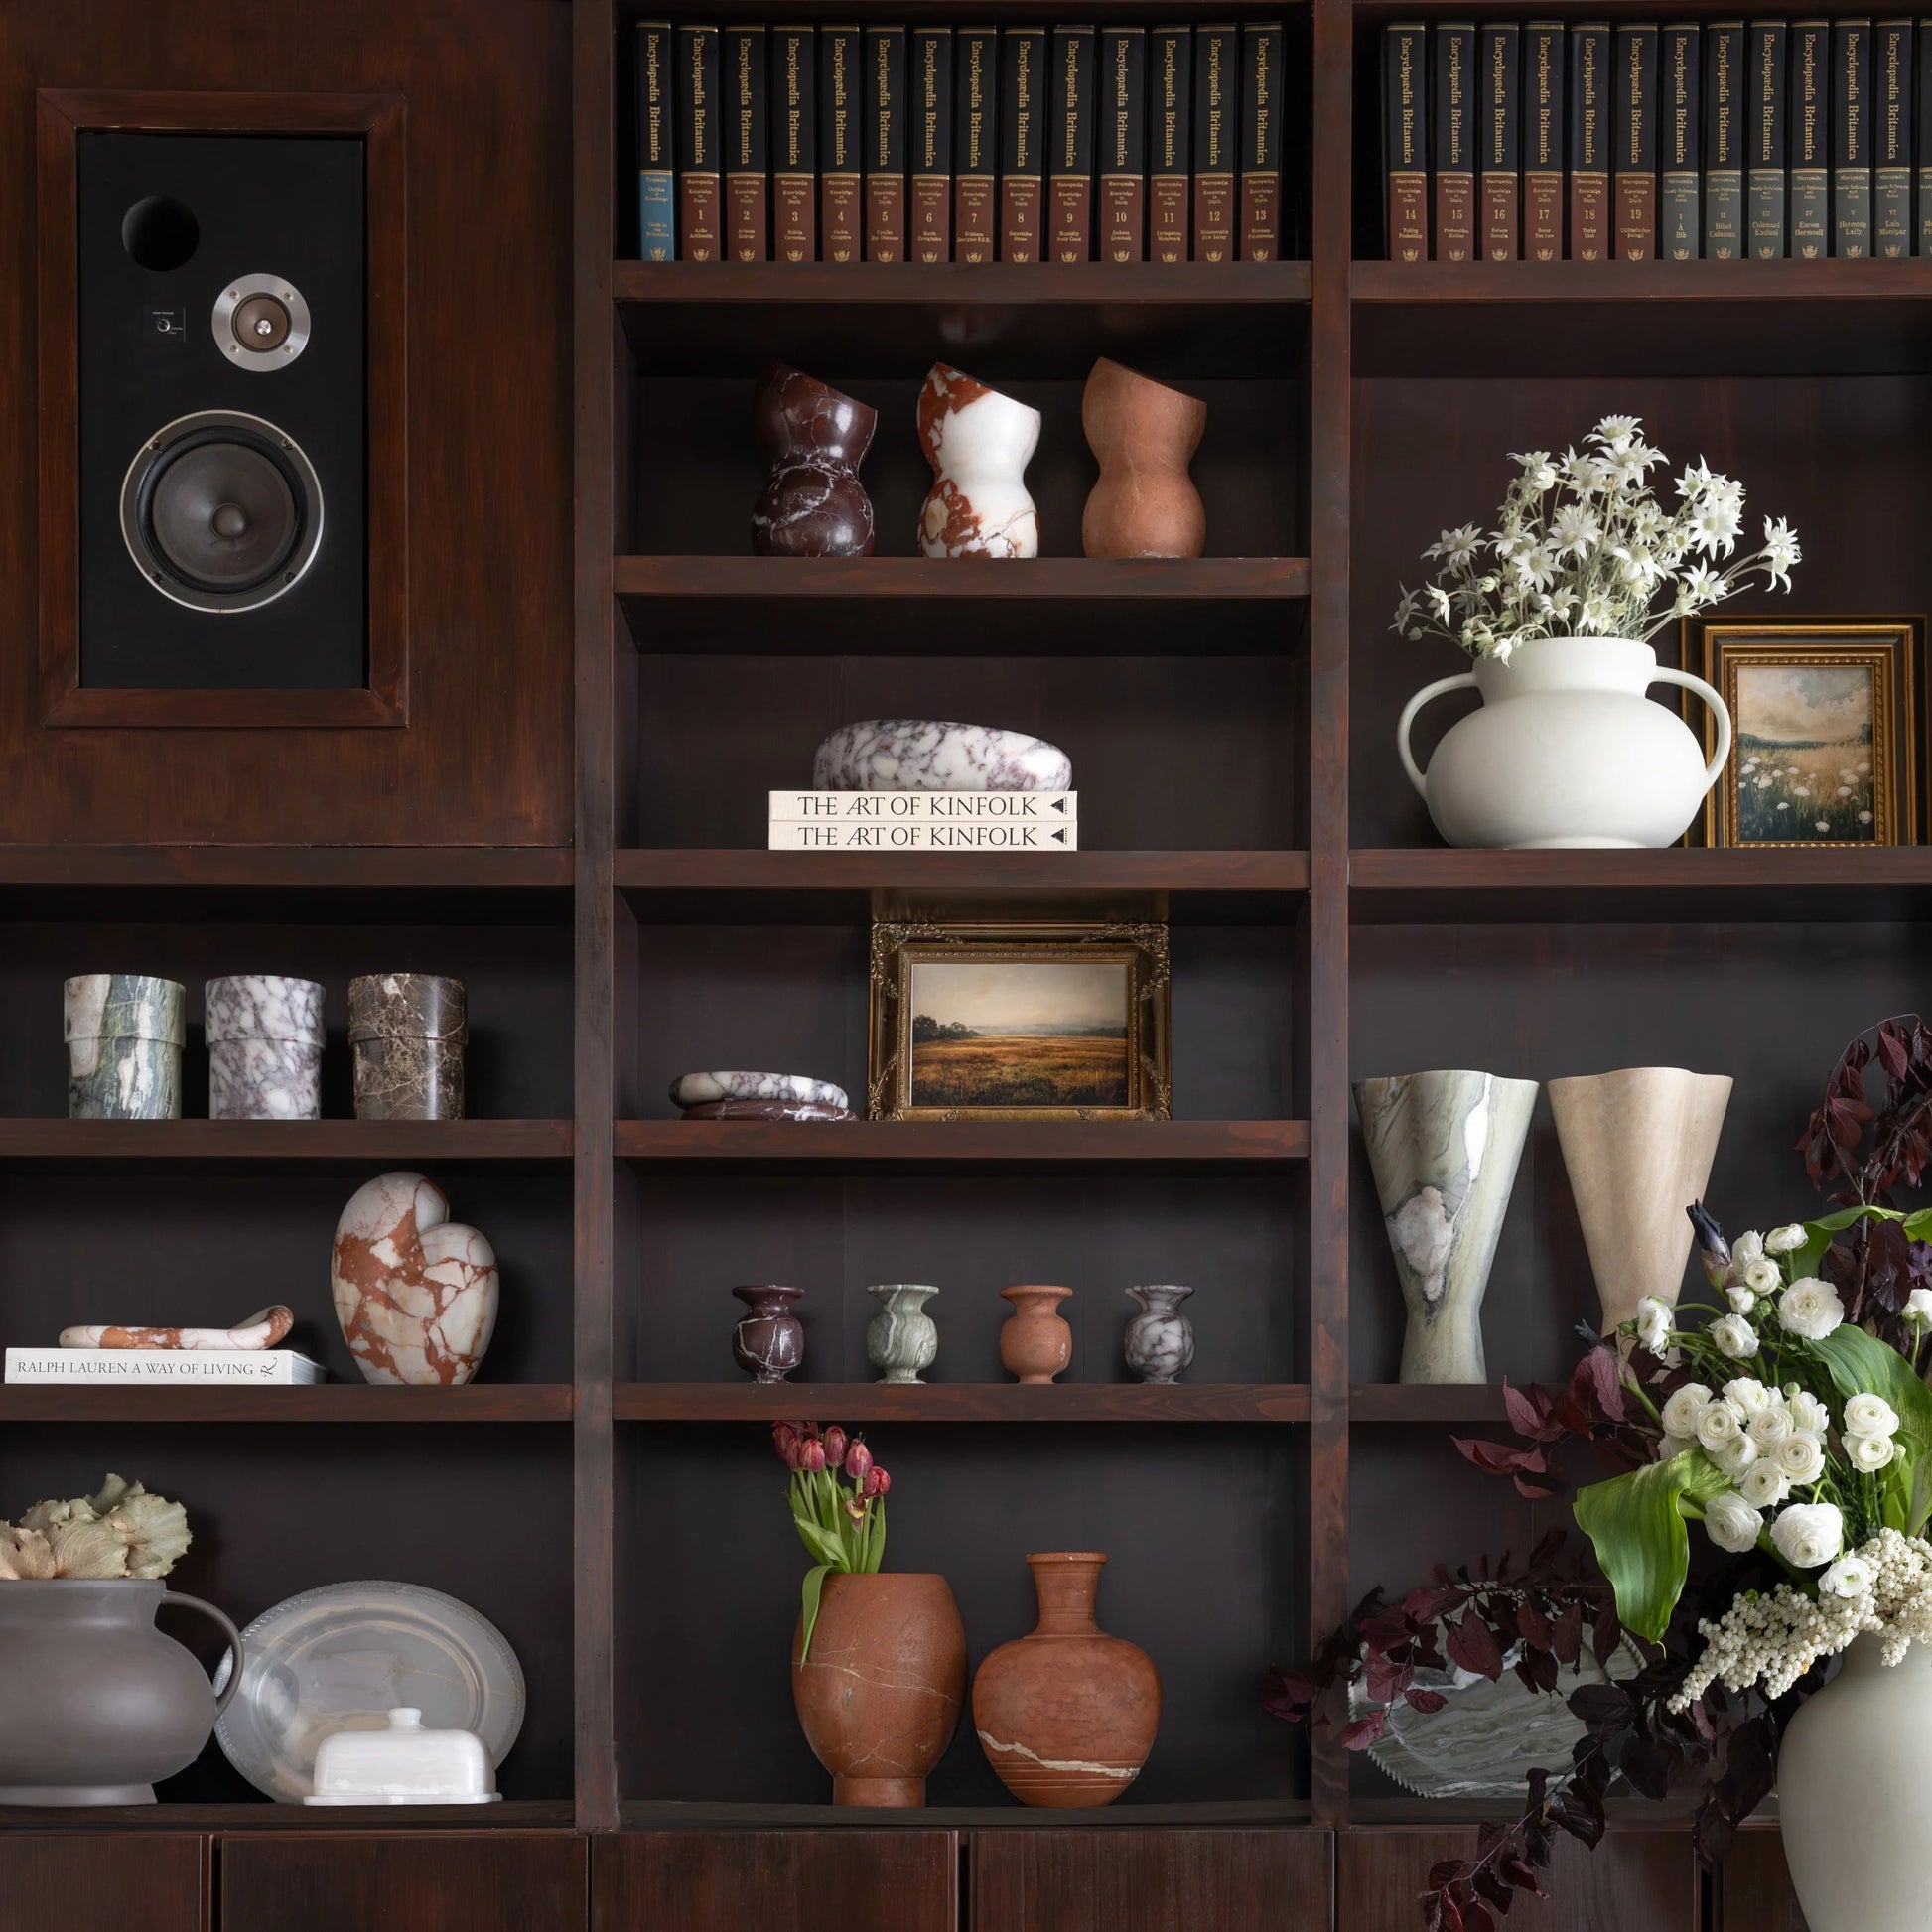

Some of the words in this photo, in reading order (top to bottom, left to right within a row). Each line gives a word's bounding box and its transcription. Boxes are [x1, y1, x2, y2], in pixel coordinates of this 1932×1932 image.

[650, 107, 660, 161] Britannica
[695, 109, 705, 164] Britannica
[741, 110, 752, 164] Britannica
[789, 110, 799, 165] Britannica
[836, 110, 846, 165] Britannica
[880, 111, 890, 166] Britannica
[926, 112, 936, 167] Britannica
[971, 112, 981, 167] Britannica
[1018, 112, 1029, 167] Britannica
[1066, 112, 1077, 167] Britannica
[1117, 111, 1128, 166] Britannica
[1166, 112, 1175, 167] Britannica
[1210, 111, 1221, 165] Britannica
[1257, 109, 1268, 164] Britannica
[1403, 109, 1413, 163] Britannica
[1451, 109, 1461, 164] Britannica
[1495, 109, 1505, 163] Britannica
[1540, 109, 1550, 163] Britannica
[1586, 109, 1595, 164] Britannica
[1631, 109, 1642, 163] Britannica
[1676, 109, 1686, 163] Britannica
[1719, 107, 1729, 162] Britannica
[1763, 106, 1773, 161] Britannica
[1805, 105, 1815, 160] Britannica
[1849, 105, 1859, 159] Britannica
[1888, 105, 1898, 159] Britannica
[697, 210, 704, 219] 1
[743, 211, 751, 220] 2
[791, 211, 799, 221] 3
[837, 211, 845, 221] 4
[881, 211, 889, 221] 5
[925, 213, 933, 222] 6
[970, 213, 978, 223] 7
[1017, 213, 1025, 222] 8
[1066, 213, 1074, 222] 9
[1115, 212, 1128, 222] 10
[1163, 213, 1175, 222] 11
[1208, 211, 1221, 221] 12
[1254, 210, 1267, 220] 13
[1404, 209, 1417, 219] 14
[1451, 210, 1463, 219] 15
[1493, 209, 1506, 219] 16
[1538, 210, 1551, 219] 17
[1584, 210, 1596, 219] 18
[1629, 209, 1642, 219] 19
[798, 797, 837, 815] THE
[847, 797, 885, 815] ART
[891, 797, 920, 815] OF
[930, 797, 1037, 815] KINFOLK
[798, 827, 837, 845] THE
[847, 827, 885, 845] ART
[891, 827, 920, 845] OF
[930, 827, 1037, 845] KINFOLK
[18, 1361, 65, 1373] RALPH
[70, 1362, 127, 1374] LAUREN
[132, 1363, 141, 1374] A
[146, 1363, 176, 1374] WAY
[180, 1364, 199, 1375] OF
[204, 1364, 253, 1375] LIVING
